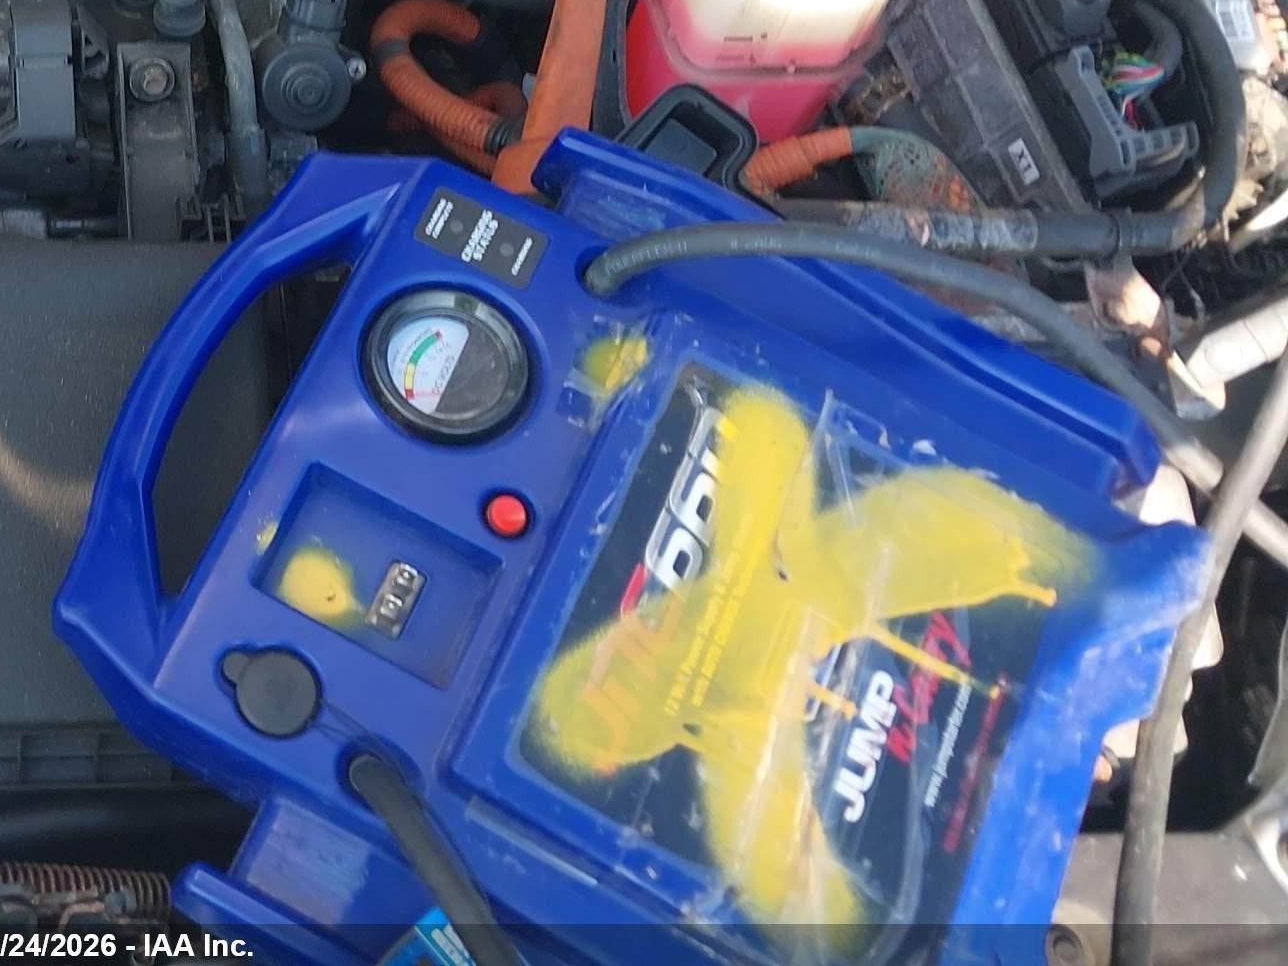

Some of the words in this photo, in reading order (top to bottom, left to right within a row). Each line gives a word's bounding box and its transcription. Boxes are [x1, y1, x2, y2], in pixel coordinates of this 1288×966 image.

[461, 209, 493, 263] CHARGING
[473, 219, 499, 262] STATUS
[892, 609, 971, 725] Cary
[833, 670, 897, 823] JUMP
